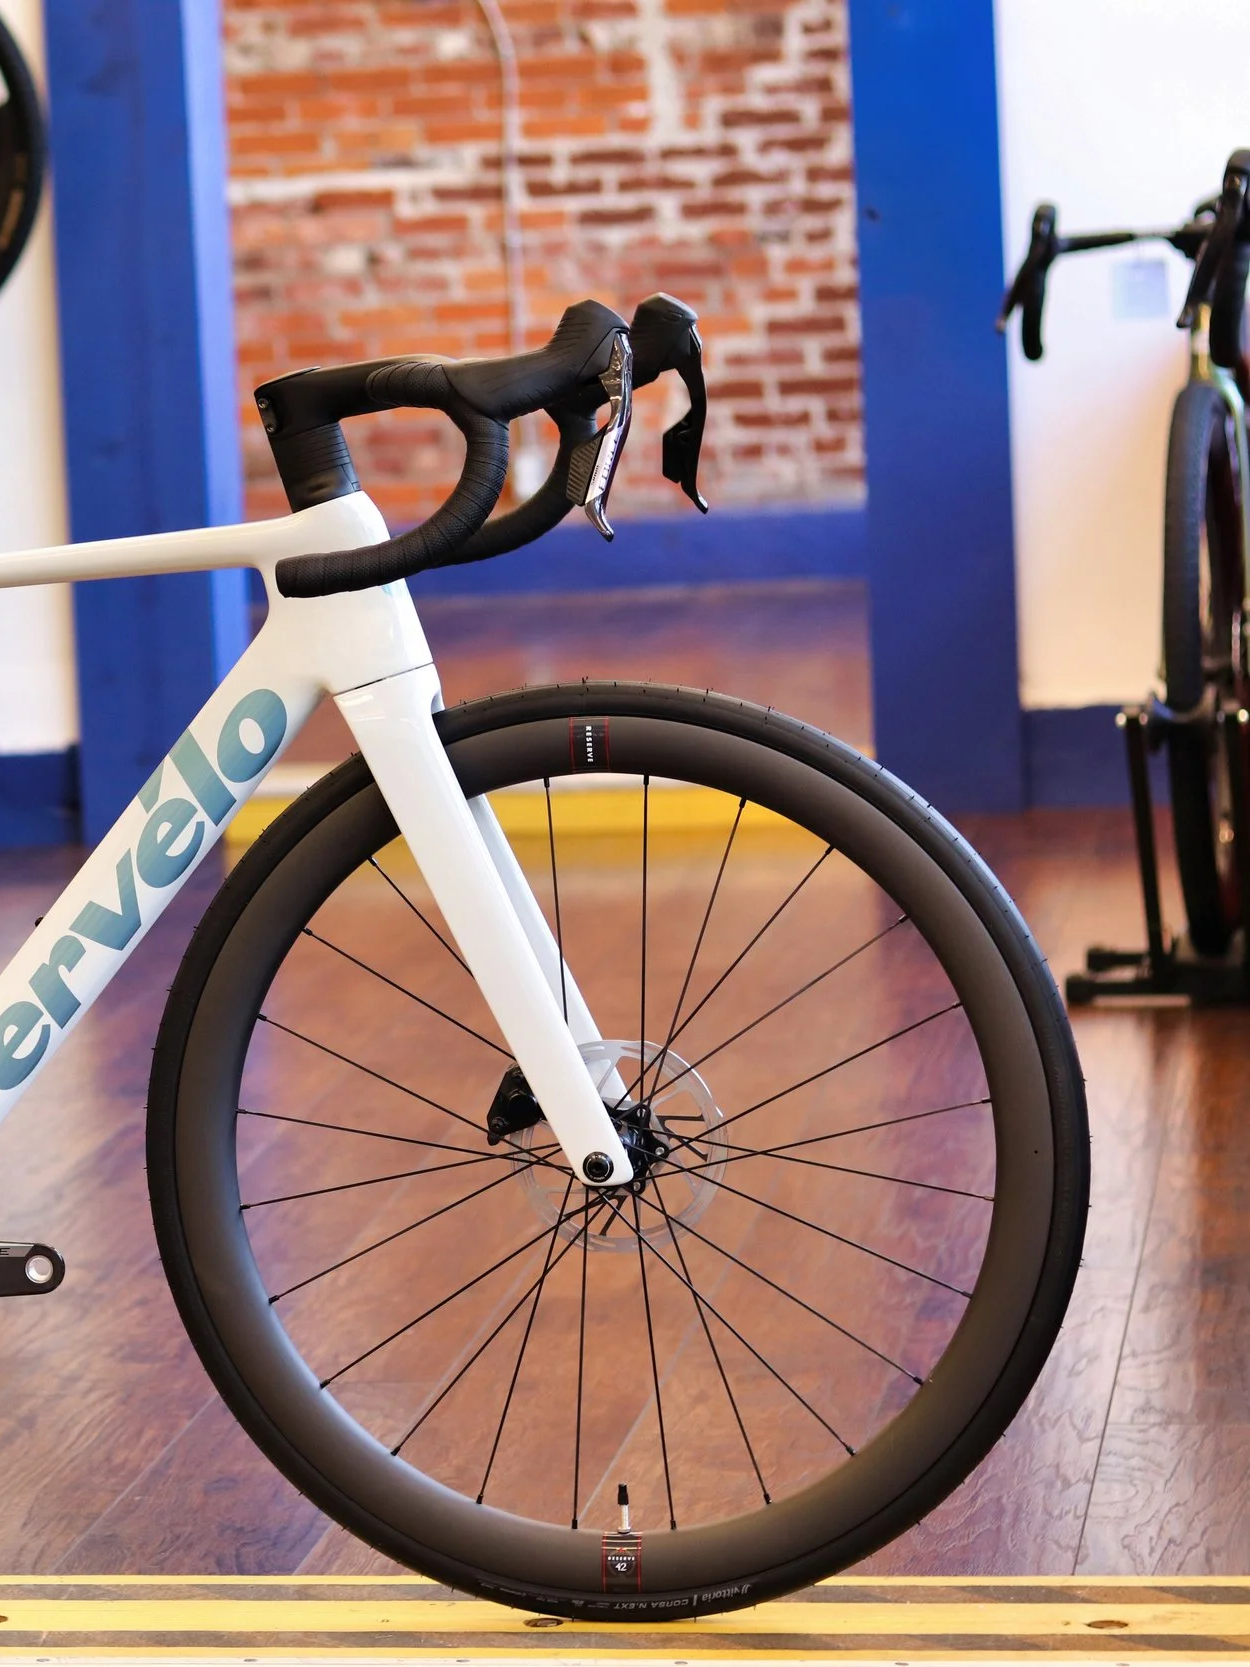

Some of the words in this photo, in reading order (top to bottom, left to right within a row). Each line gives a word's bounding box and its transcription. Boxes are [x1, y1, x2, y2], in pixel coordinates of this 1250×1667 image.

[585, 725, 593, 762] RESERVE
[615, 1562, 627, 1572] 42
[701, 1586, 741, 1603] vittoria
